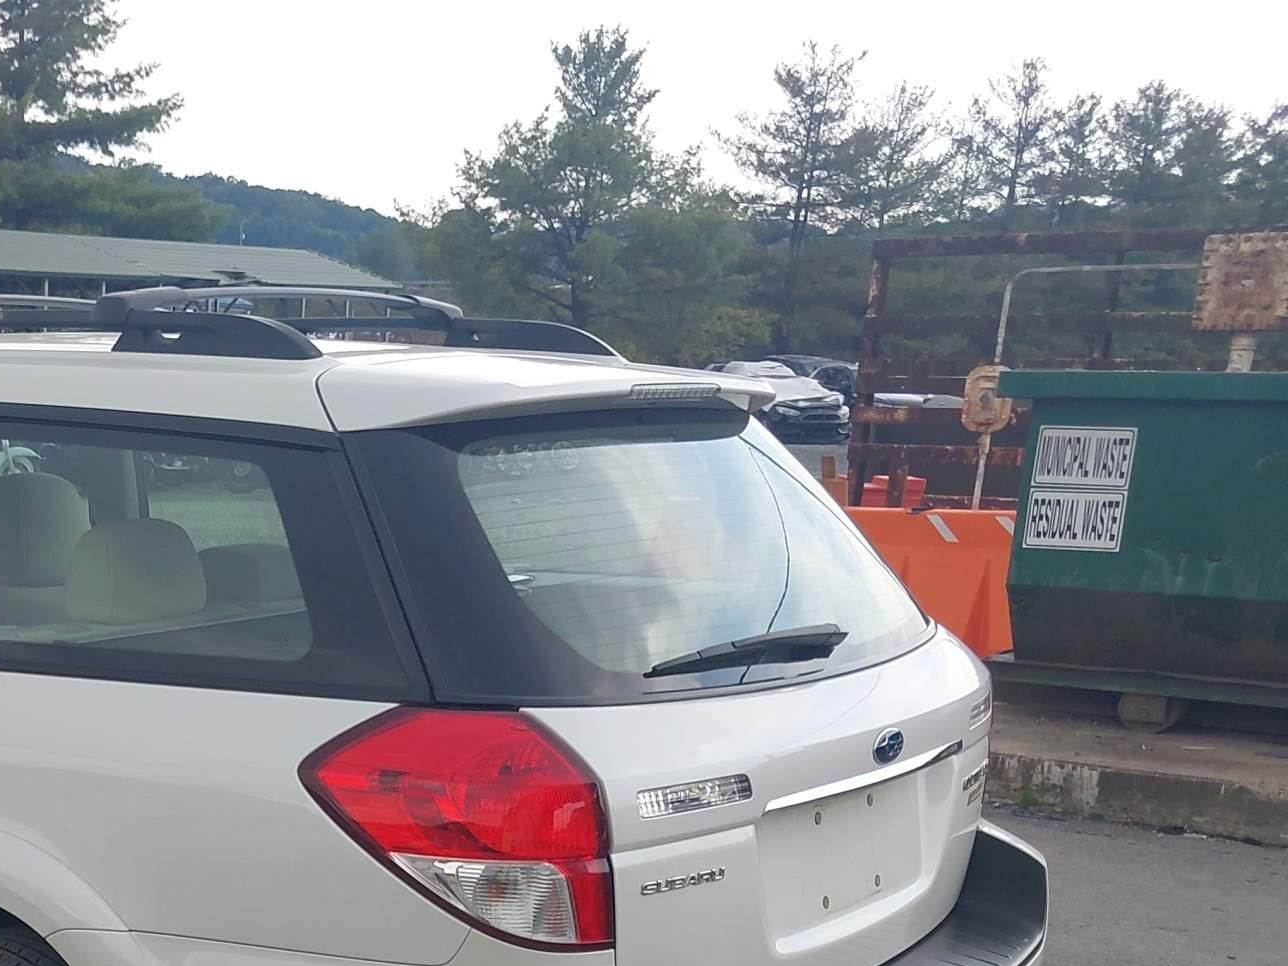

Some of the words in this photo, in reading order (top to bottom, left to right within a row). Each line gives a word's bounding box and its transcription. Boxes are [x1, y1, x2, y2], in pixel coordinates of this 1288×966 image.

[1038, 436, 1091, 478] MUNICIPAL
[1092, 437, 1130, 479] WASTE
[1028, 498, 1079, 540] RESIDUAL
[1081, 500, 1120, 542] WASTE
[640, 866, 726, 896] SUBARU
